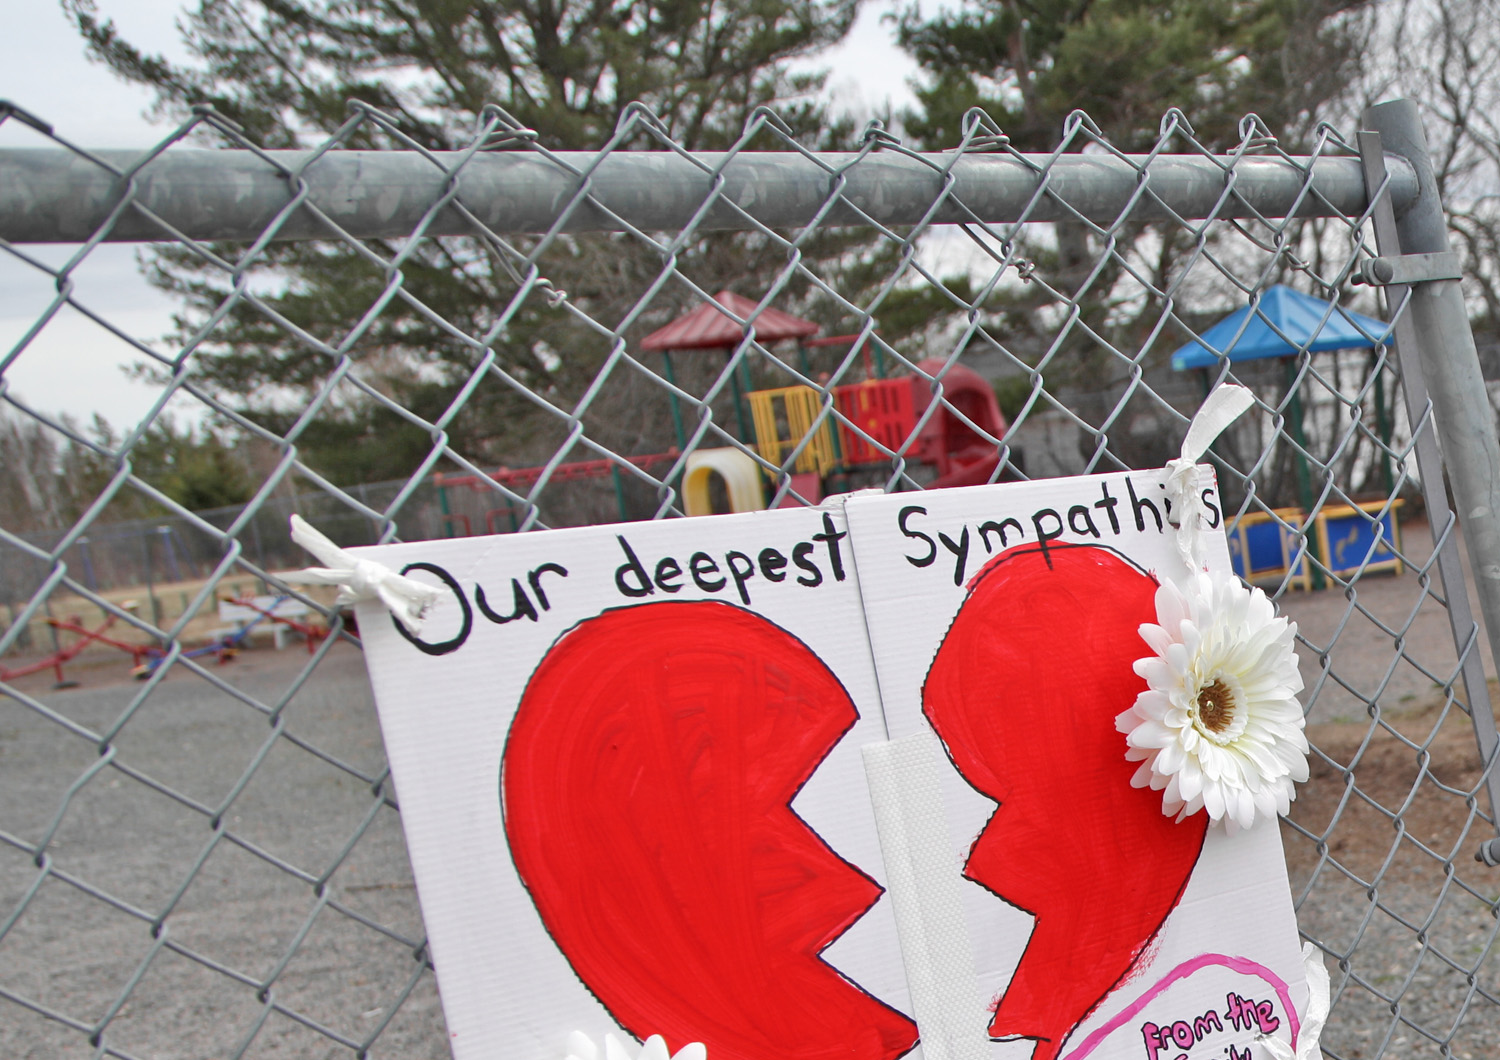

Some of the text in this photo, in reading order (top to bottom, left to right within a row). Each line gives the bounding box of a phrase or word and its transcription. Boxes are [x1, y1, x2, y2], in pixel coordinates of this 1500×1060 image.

[392, 476, 1220, 656] Our deepest Sympathis
[1224, 991, 1280, 1034] the
